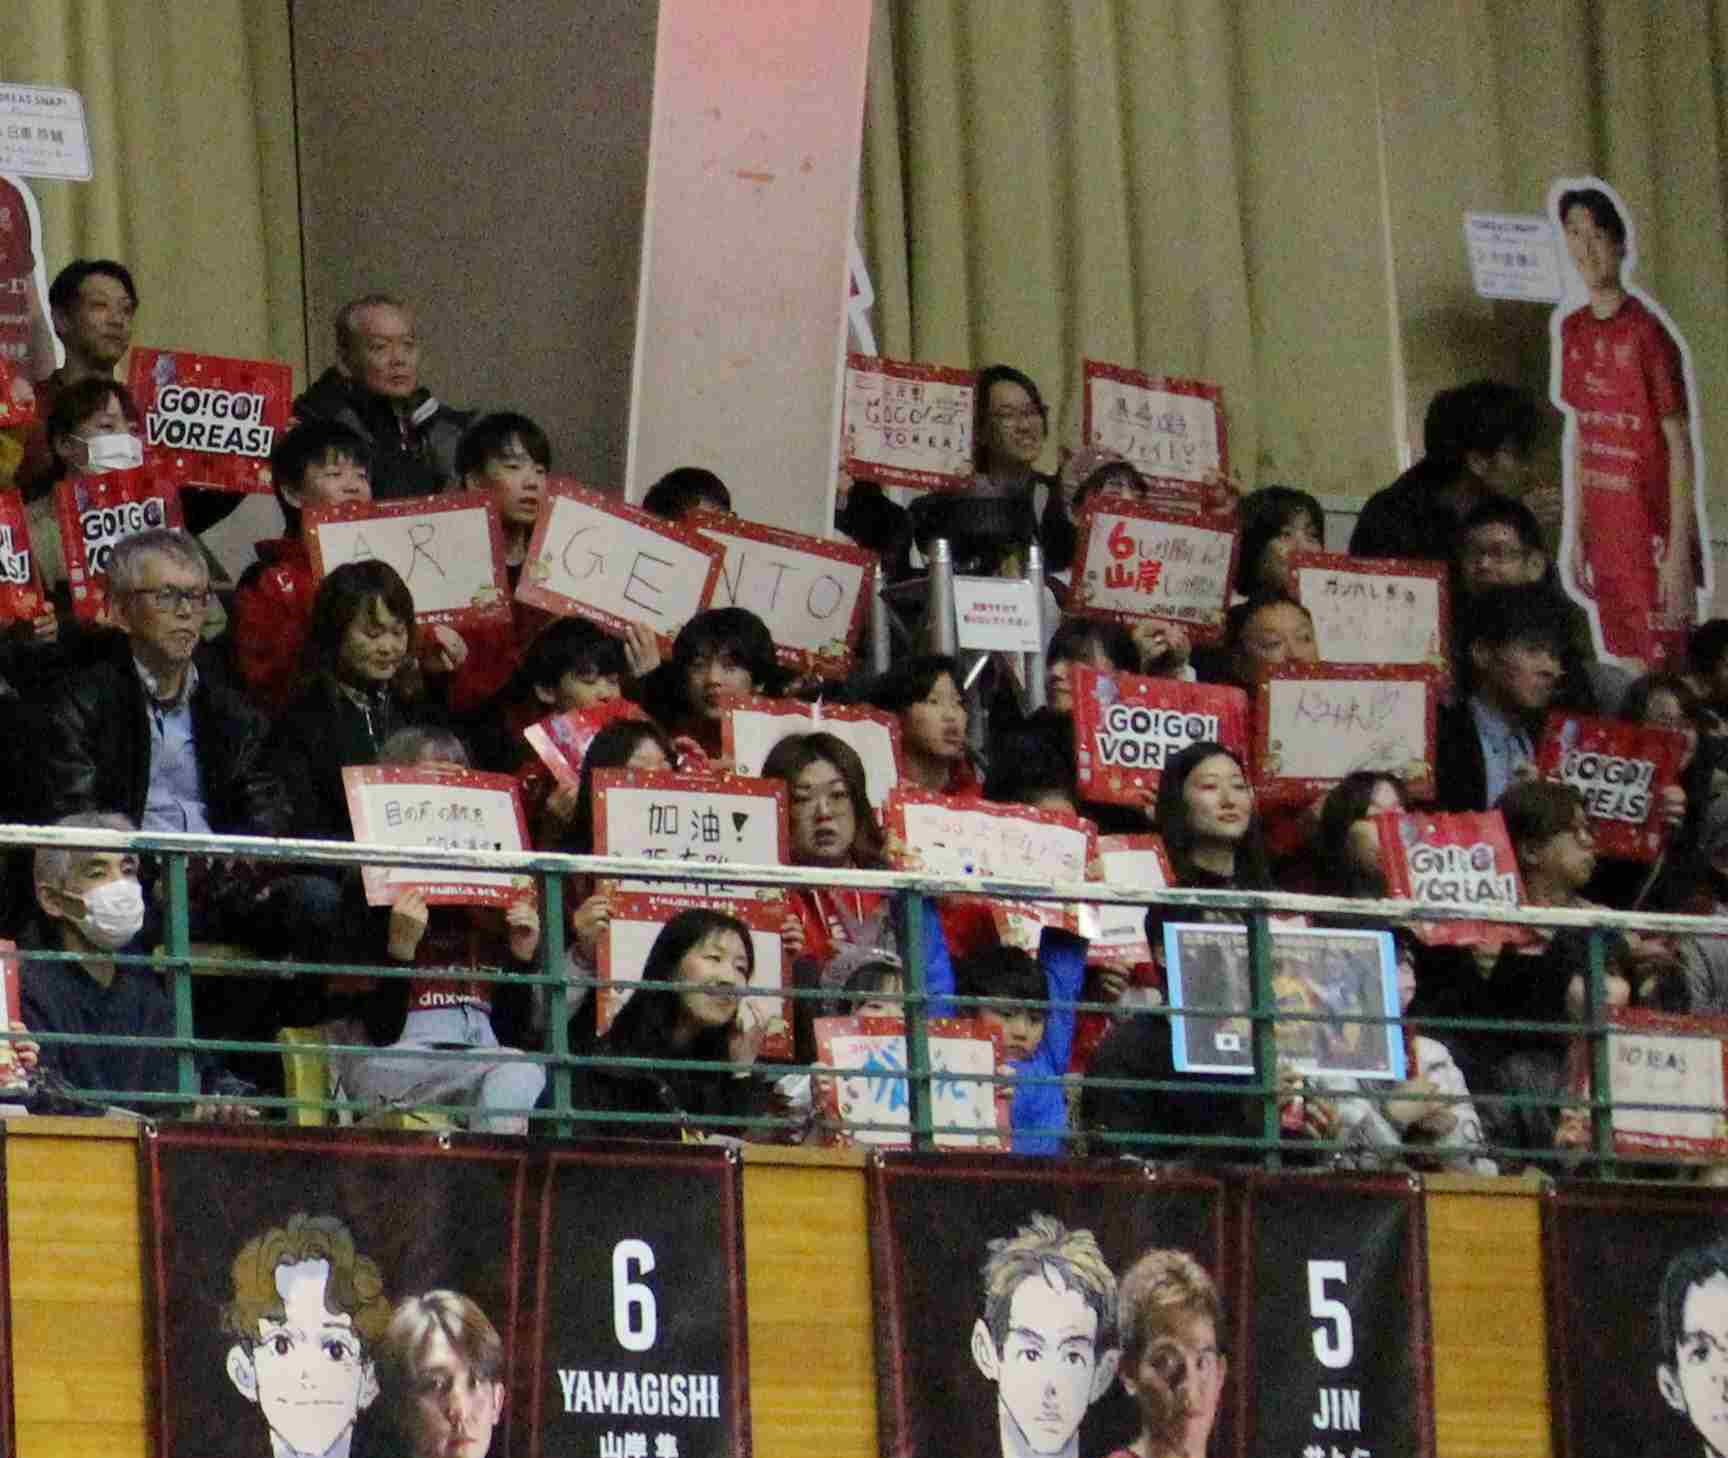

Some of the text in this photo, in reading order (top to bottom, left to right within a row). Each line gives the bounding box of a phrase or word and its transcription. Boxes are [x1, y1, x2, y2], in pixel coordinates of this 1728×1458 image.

[160, 388, 262, 420] GO!GO!
[146, 415, 273, 455] VOREAS!
[1107, 520, 1136, 560] 6
[562, 528, 674, 615] GE
[1103, 559, 1162, 594] 山岸
[1110, 708, 1215, 739] GO!GO!
[612, 1238, 656, 1352] 6
[1307, 1260, 1355, 1369] 5
[557, 1369, 721, 1418] YAMAGISHI
[1312, 1388, 1361, 1432] JIN
